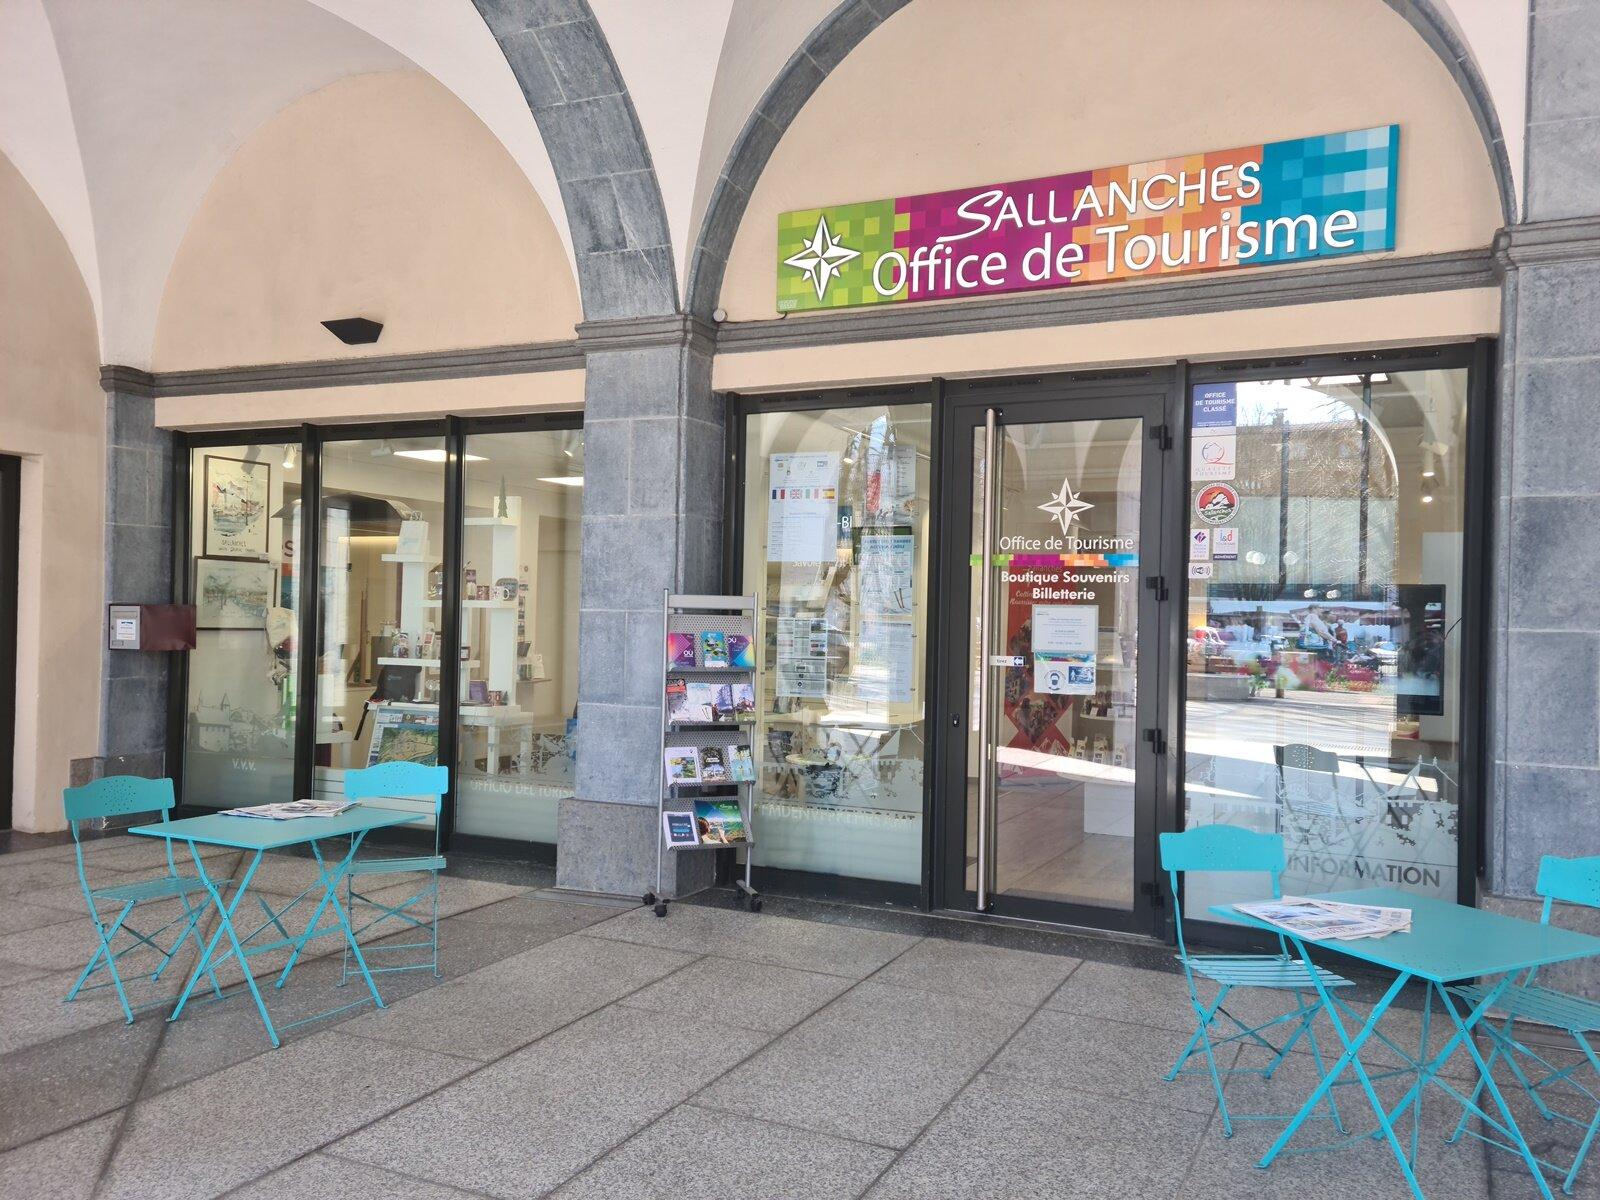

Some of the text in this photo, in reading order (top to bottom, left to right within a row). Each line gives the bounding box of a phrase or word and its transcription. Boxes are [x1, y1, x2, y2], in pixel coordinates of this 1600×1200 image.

[936, 160, 1262, 243] SALLANCHES
[871, 208, 1359, 298] Office de Tourisme
[1204, 391, 1227, 399] OFFICE
[1000, 535, 1134, 551] Office de Tourisme
[1001, 570, 1130, 585] Boutique Souvenirs
[1032, 587, 1096, 600] Billetterie
[1286, 853, 1441, 889] INFORMATION
